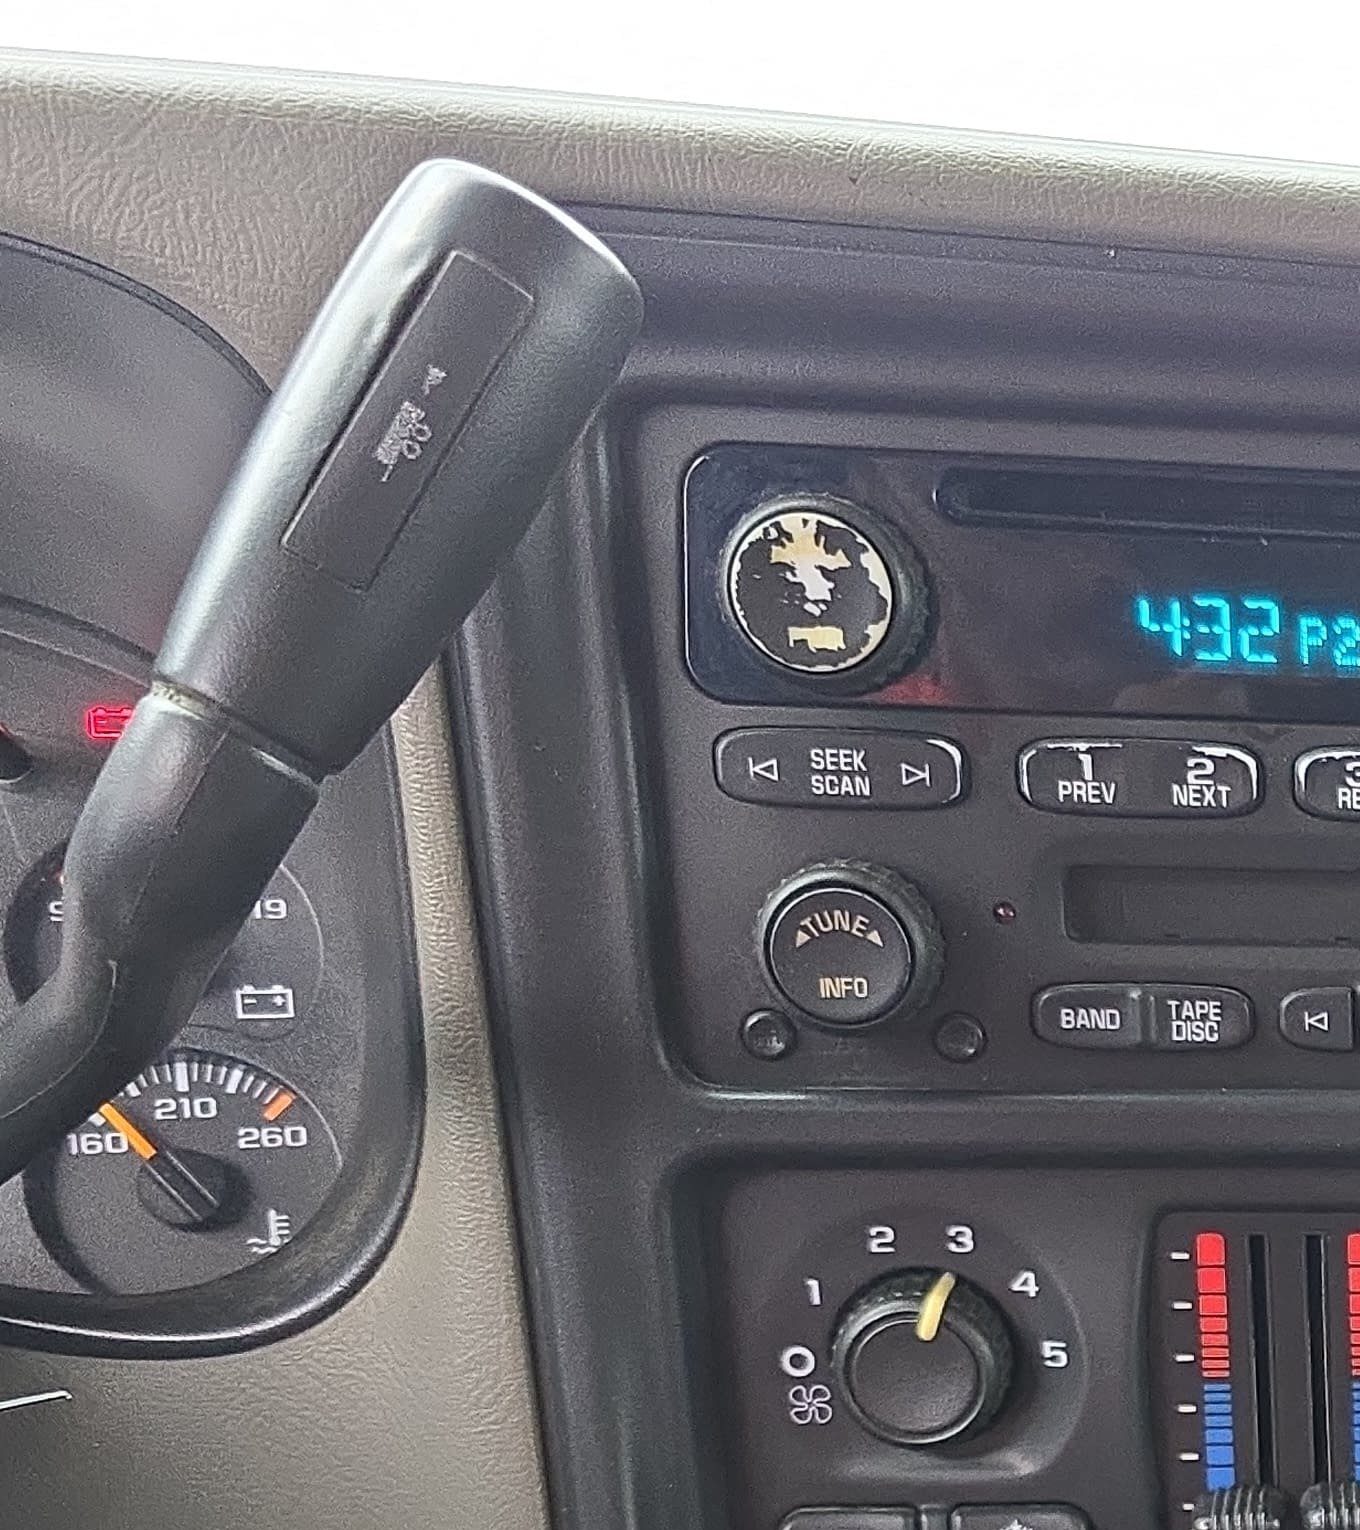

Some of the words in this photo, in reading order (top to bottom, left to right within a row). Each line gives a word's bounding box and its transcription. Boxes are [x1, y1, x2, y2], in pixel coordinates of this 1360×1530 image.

[810, 748, 867, 772] SEEK
[1077, 754, 1093, 781] 1
[1187, 758, 1214, 785] 2
[810, 774, 870, 797] SCAN
[1058, 780, 1116, 805] PREV
[1172, 783, 1232, 808] NEXT
[801, 908, 869, 939] TUNE
[819, 976, 868, 999] INFO
[1060, 1008, 1121, 1030] BAND
[1168, 1000, 1222, 1023] TAPE
[1171, 1021, 1219, 1042] DISC
[154, 1097, 218, 1121] 210
[68, 1132, 129, 1155] 160
[237, 1125, 308, 1149] 260
[868, 1226, 895, 1253] 2
[946, 1225, 974, 1253] 3
[805, 1278, 821, 1305] 1
[1010, 1271, 1040, 1298] 4
[1041, 1340, 1068, 1368] 5
